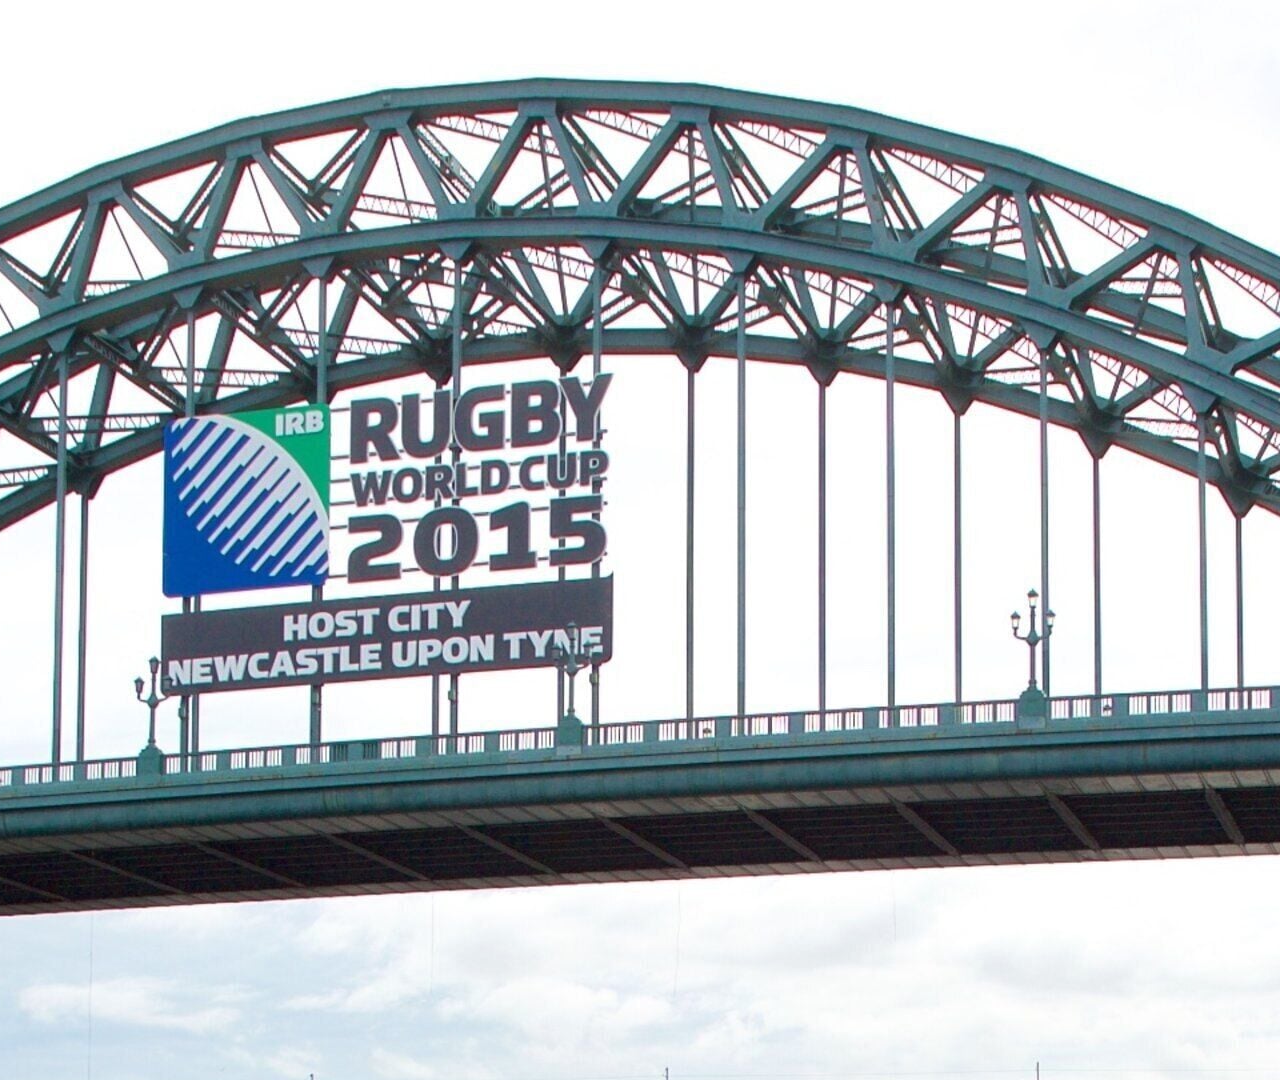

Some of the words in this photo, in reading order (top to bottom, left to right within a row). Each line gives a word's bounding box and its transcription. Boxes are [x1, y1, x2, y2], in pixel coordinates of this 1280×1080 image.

[275, 411, 324, 436] IRB
[350, 373, 613, 464] RUGBY
[350, 459, 510, 507] WORLD
[519, 450, 609, 491] CUP
[347, 494, 607, 583] 2015
[283, 607, 380, 641] HOST
[388, 600, 471, 632] CITY
[168, 643, 382, 686] NEWCASTLE
[391, 634, 494, 667] UPON
[503, 626, 603, 659] TYNE
